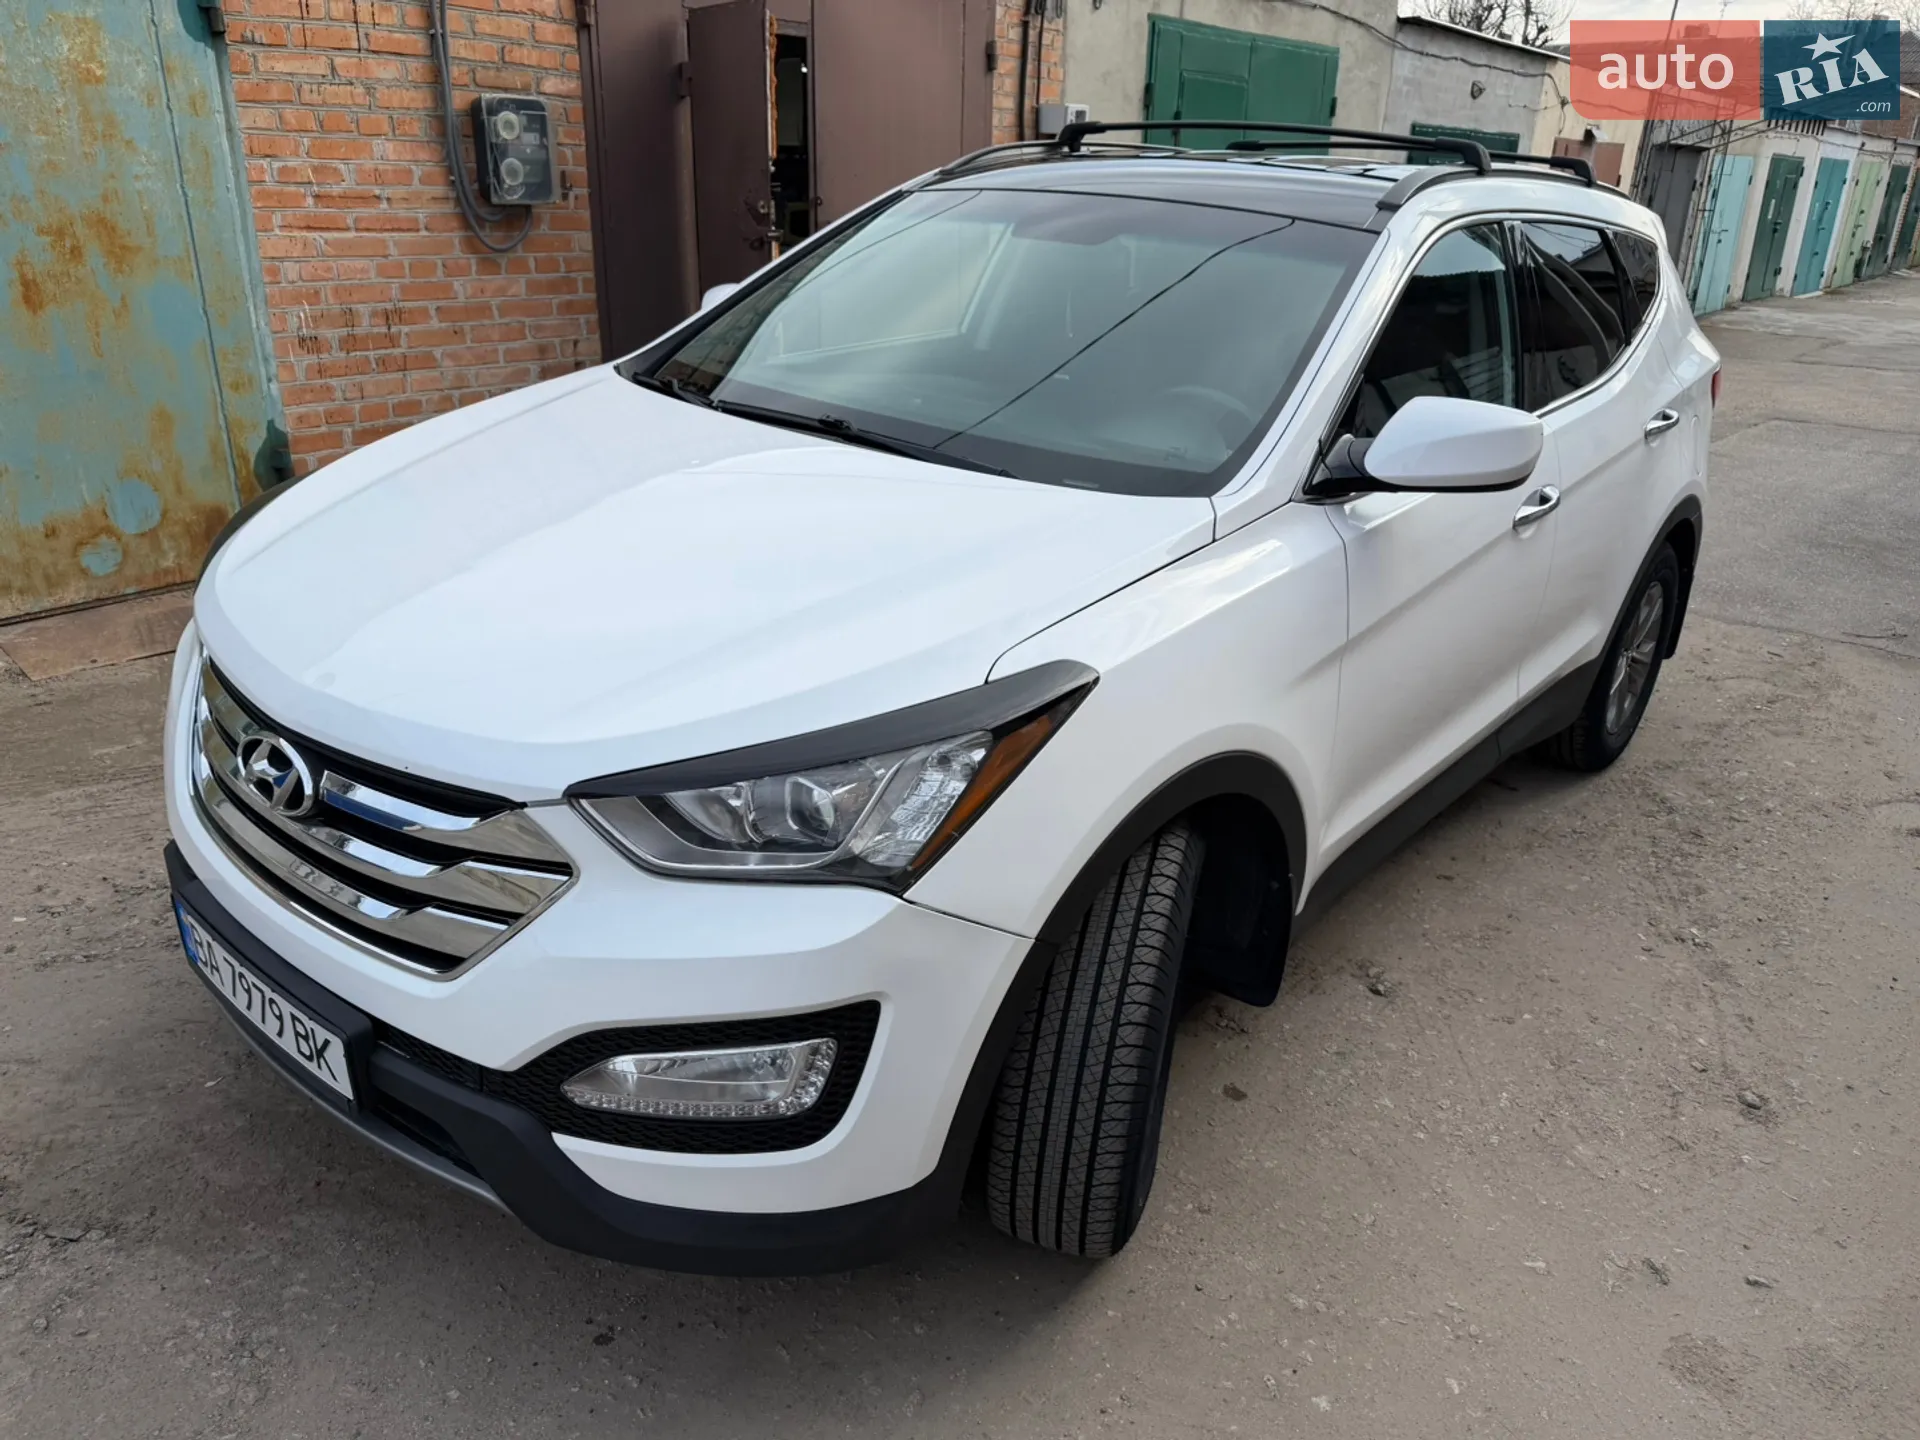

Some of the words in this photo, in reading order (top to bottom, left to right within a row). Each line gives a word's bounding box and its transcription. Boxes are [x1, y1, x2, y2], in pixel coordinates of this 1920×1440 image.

[190, 920, 225, 988] BA
[223, 955, 285, 1038] 7979
[290, 1011, 339, 1083] BK
